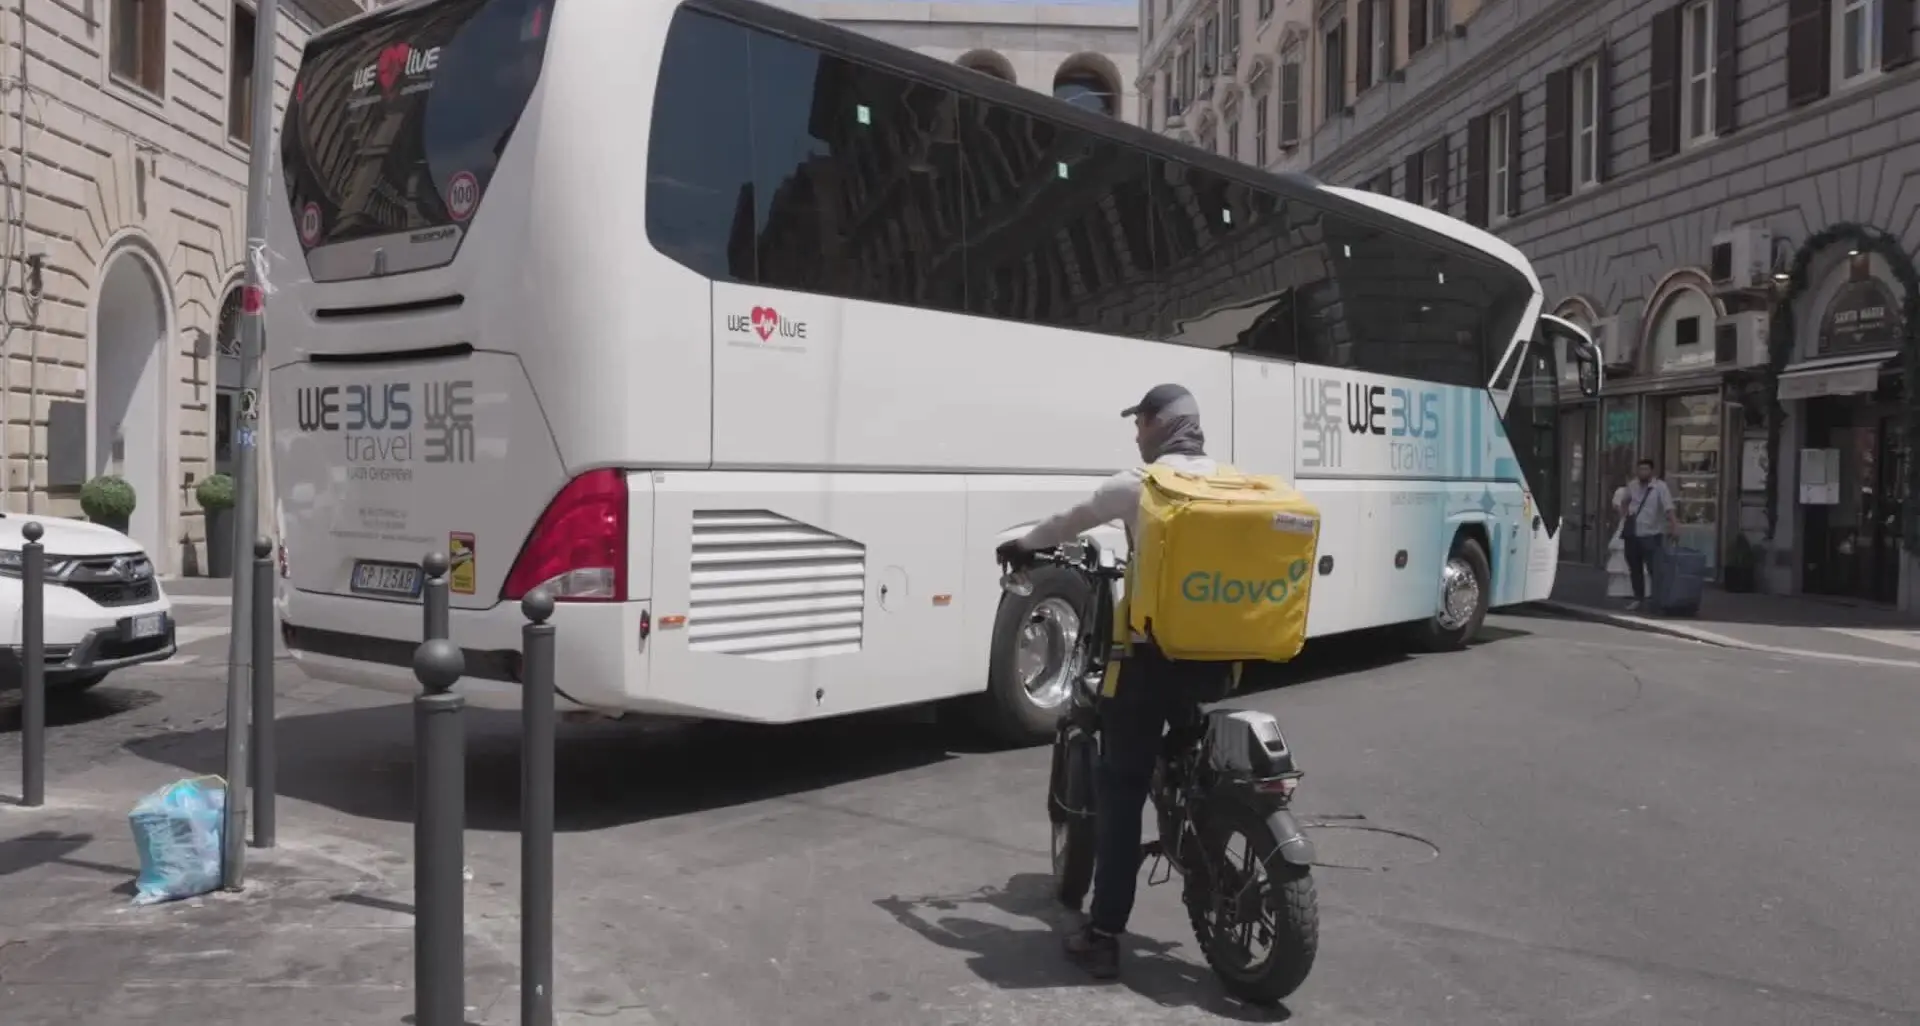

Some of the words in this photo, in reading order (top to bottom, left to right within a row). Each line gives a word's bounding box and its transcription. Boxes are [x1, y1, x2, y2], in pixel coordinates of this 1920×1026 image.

[352, 64, 377, 91] WE
[453, 186, 472, 205] 100
[727, 314, 750, 332] WE
[298, 386, 340, 431] WE
[1347, 382, 1386, 435] WE
[344, 432, 413, 461] travel
[1390, 440, 1440, 471] travel
[1182, 570, 1288, 604] Glovo
